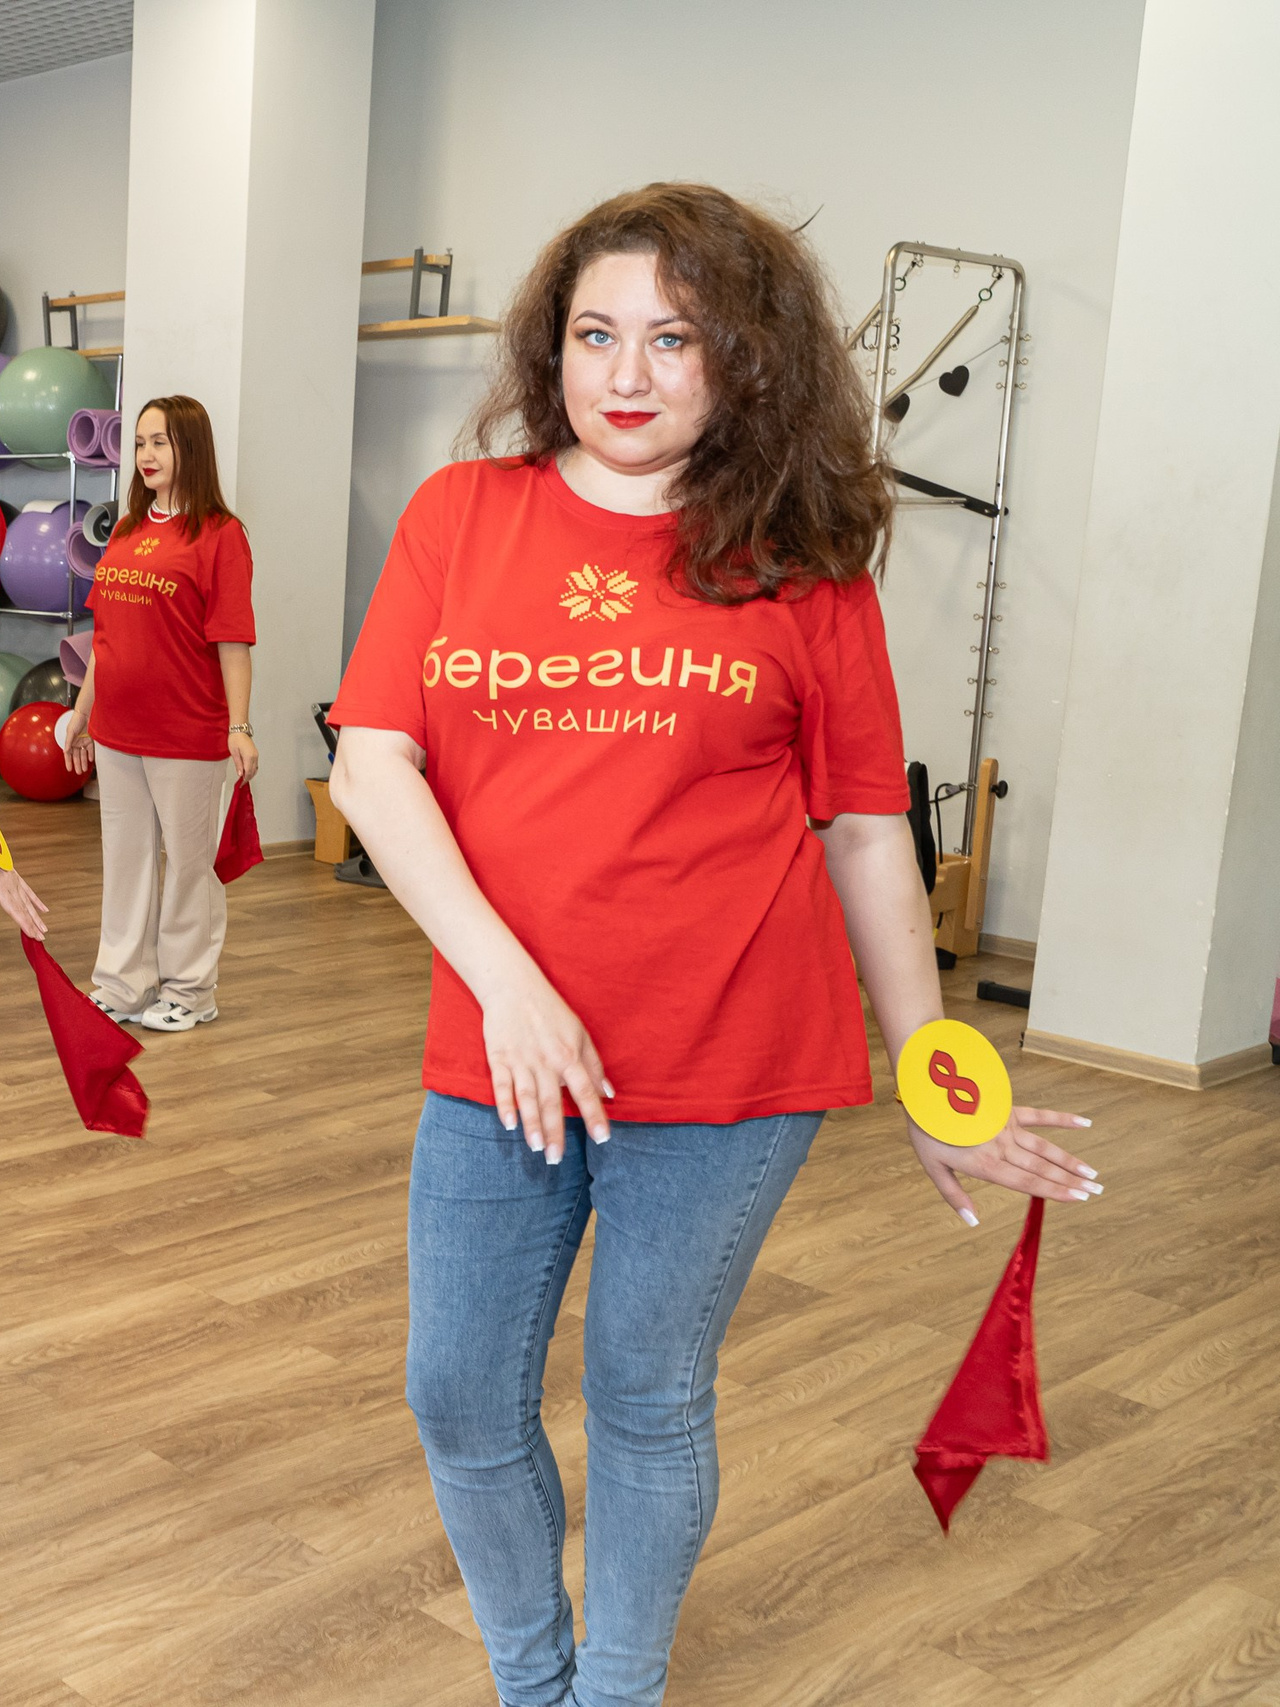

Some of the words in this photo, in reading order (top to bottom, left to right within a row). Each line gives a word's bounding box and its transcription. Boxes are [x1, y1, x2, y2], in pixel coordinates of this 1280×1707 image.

[94, 565, 178, 598] ерегиня
[100, 589, 153, 606] чувашии
[422, 636, 759, 704] берегиня
[472, 708, 677, 736] чувашии
[928, 1049, 981, 1115] 8
